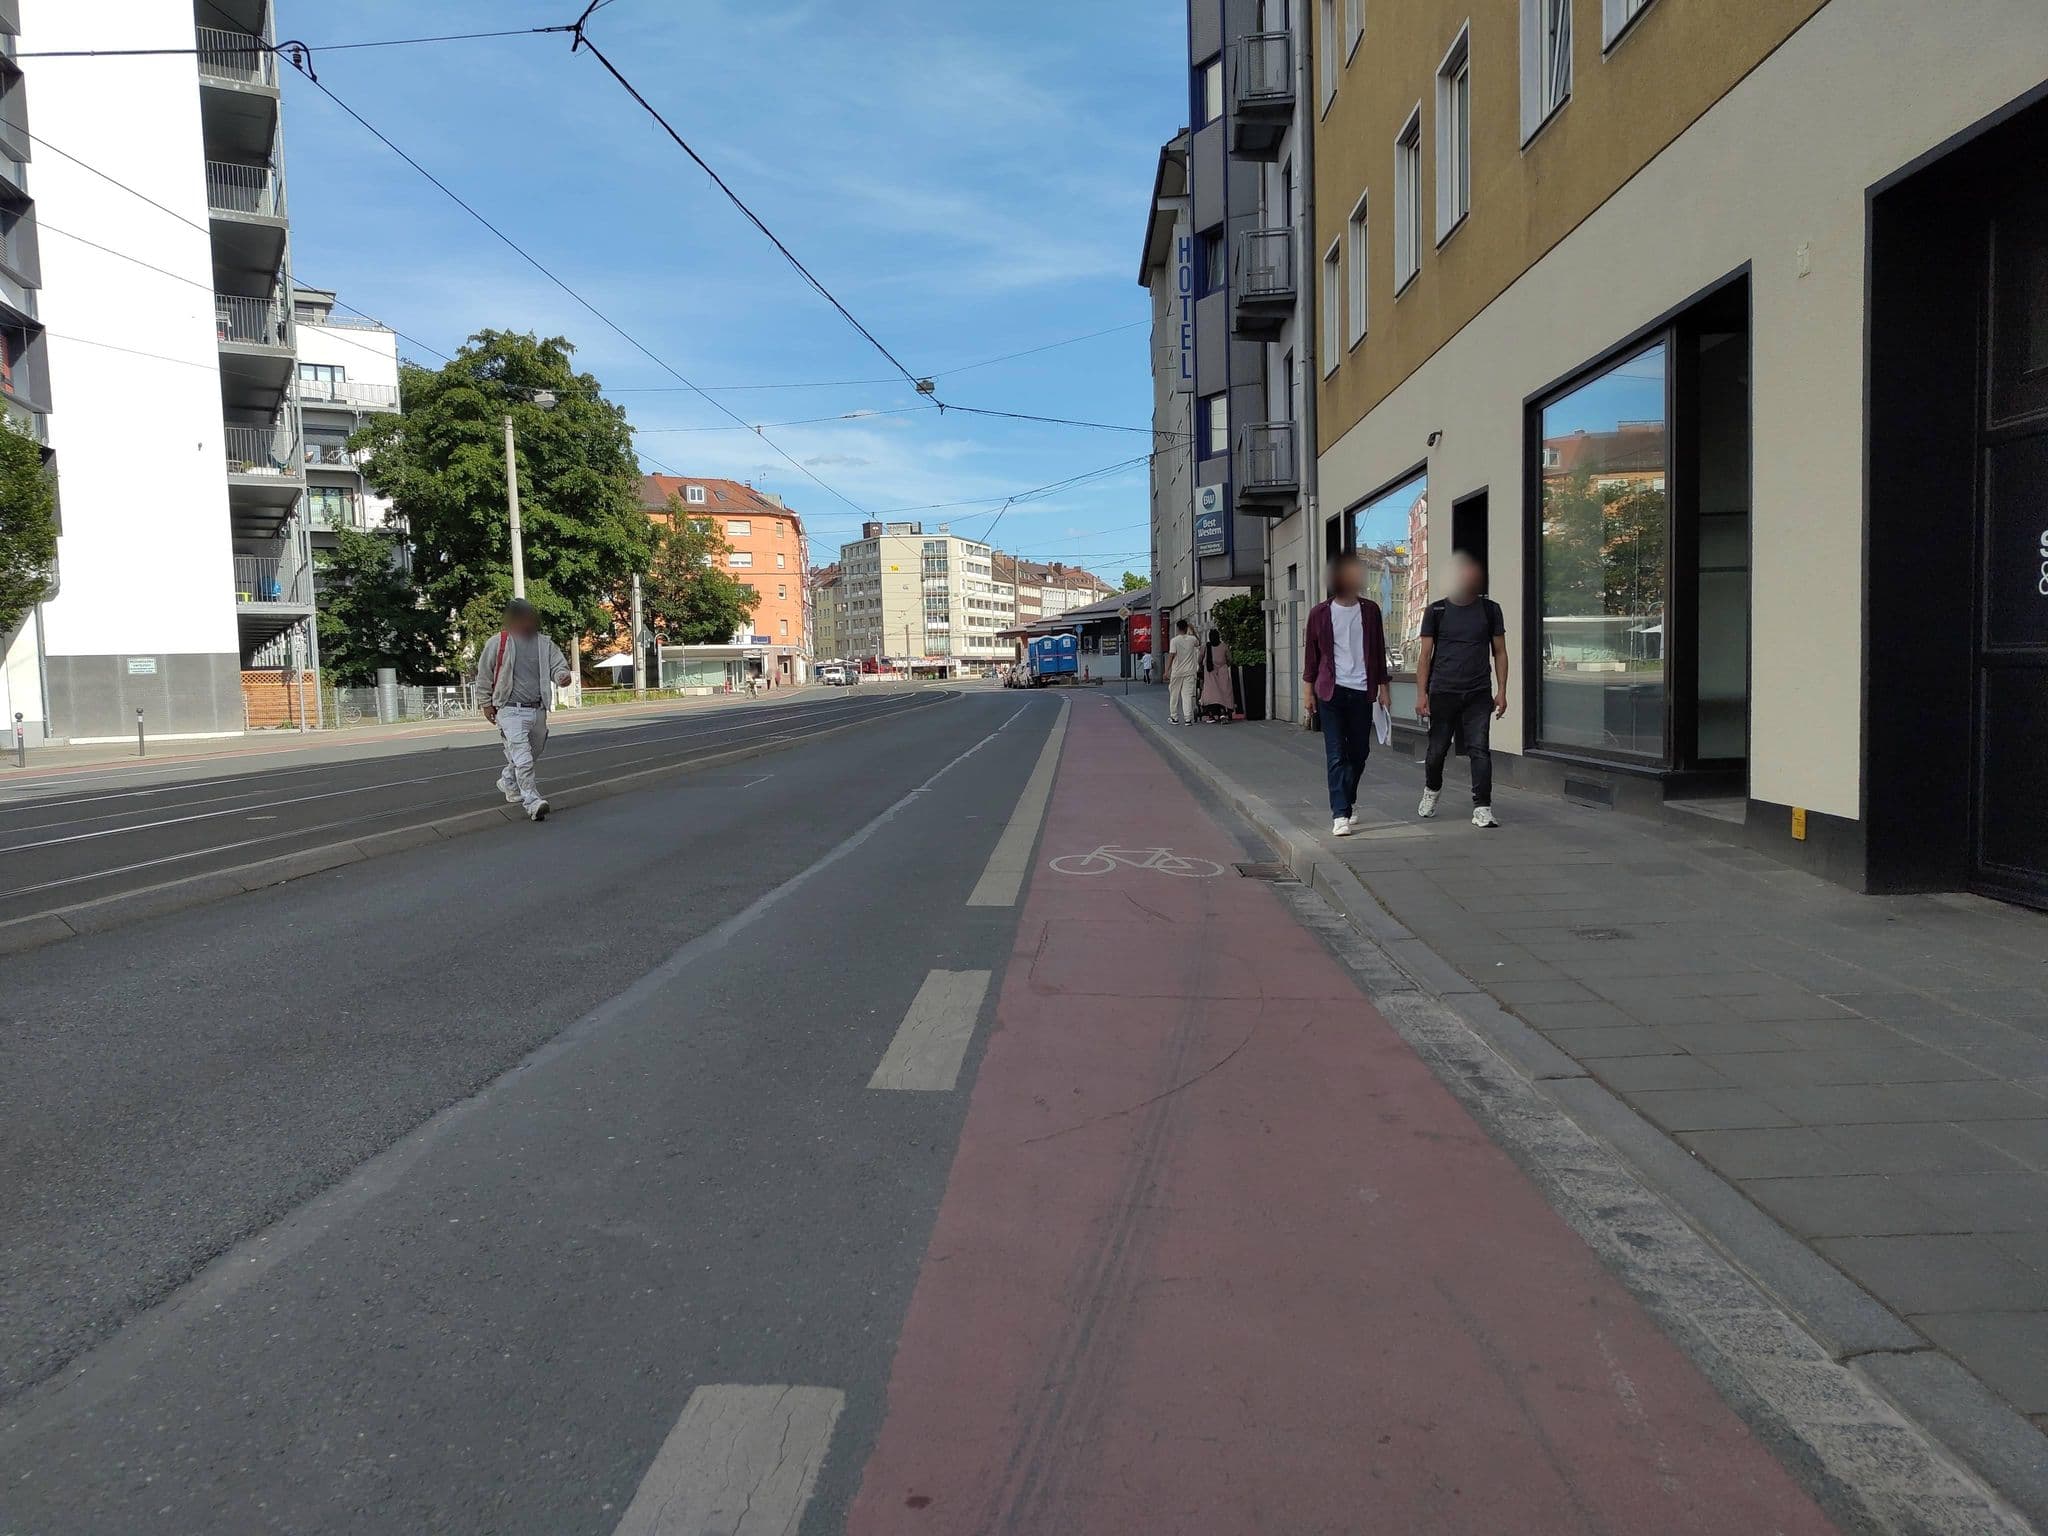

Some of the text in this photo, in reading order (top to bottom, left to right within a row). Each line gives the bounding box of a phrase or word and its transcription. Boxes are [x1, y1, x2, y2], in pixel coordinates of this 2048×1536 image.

[1179, 236, 1192, 379] HOTEL
[1203, 494, 1215, 506] BW
[1202, 518, 1217, 529] Best
[1197, 527, 1222, 538] Western
